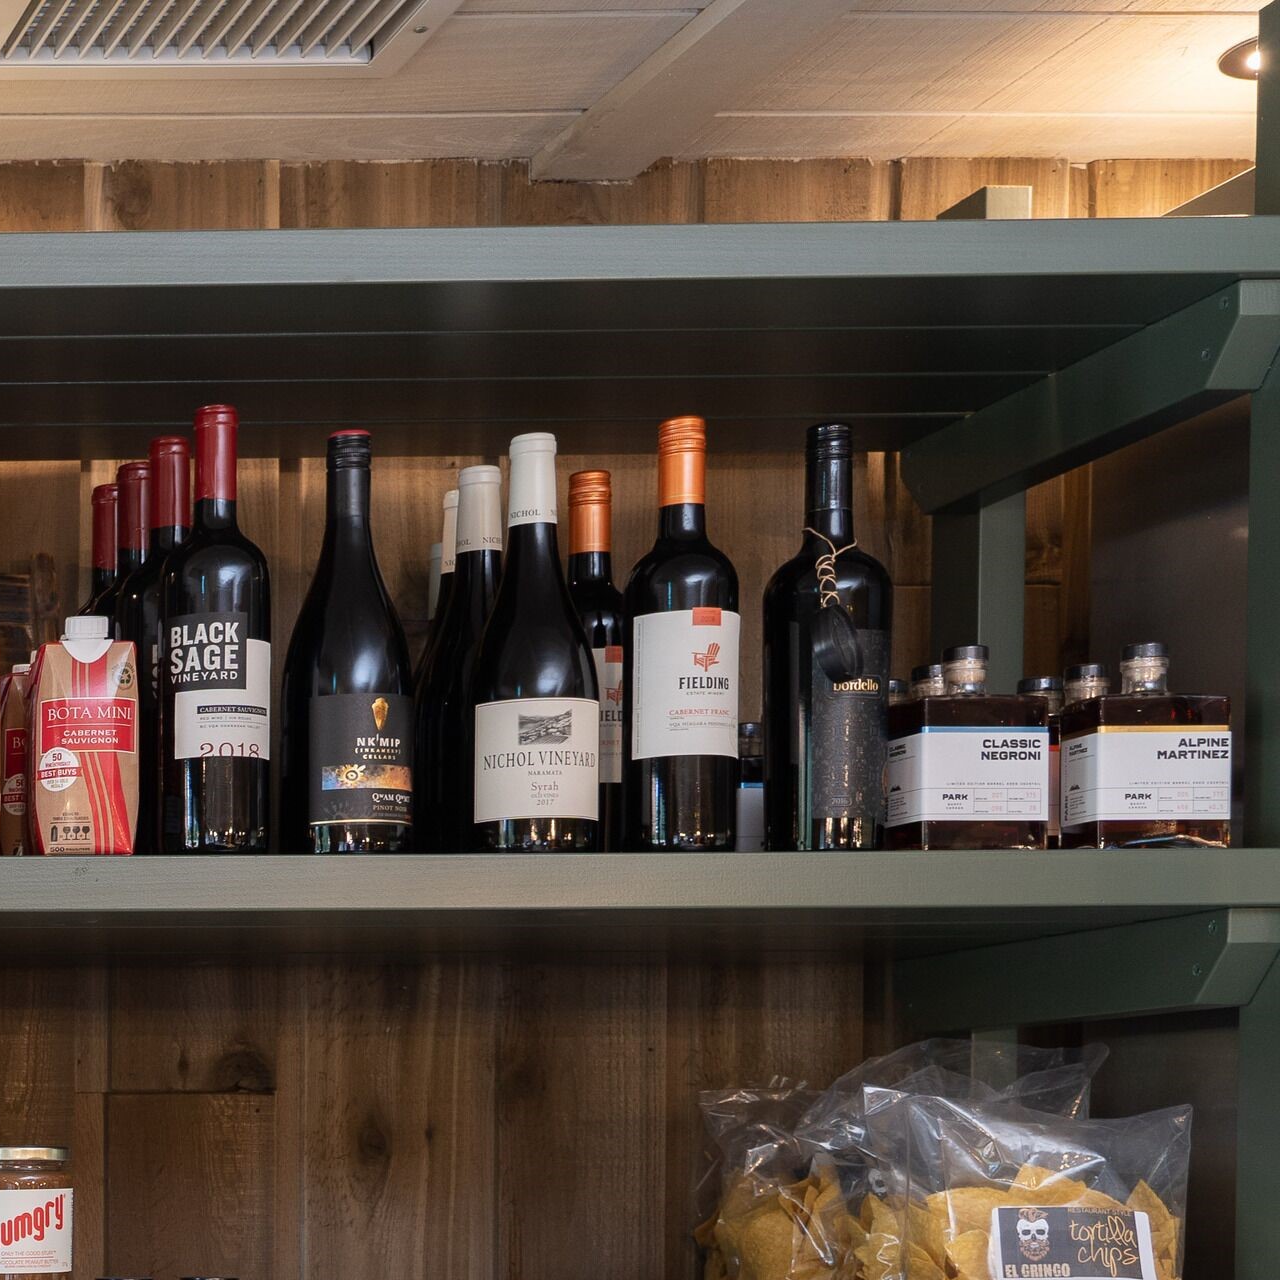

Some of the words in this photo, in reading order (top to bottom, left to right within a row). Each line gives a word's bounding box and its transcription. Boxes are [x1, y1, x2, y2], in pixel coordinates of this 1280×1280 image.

[171, 622, 239, 648] BLACK
[171, 645, 239, 674] SAGE
[171, 671, 238, 684] VINEYARD
[679, 676, 729, 690] FIELDING
[982, 739, 1041, 748] CLASSIC
[1178, 738, 1229, 747] ALPINE
[200, 743, 260, 757] 2018
[981, 750, 1041, 760] NEGRONI
[1157, 750, 1229, 759] MARTINEZ
[484, 751, 534, 770] NICHOL
[538, 751, 596, 768] VINEYARD
[531, 782, 559, 792] Syrah
[1070, 1216, 1137, 1248] tortilla
[1078, 1243, 1139, 1278] chips
[1005, 1265, 1018, 1278] EL
[1020, 1263, 1071, 1278] GRINGO
